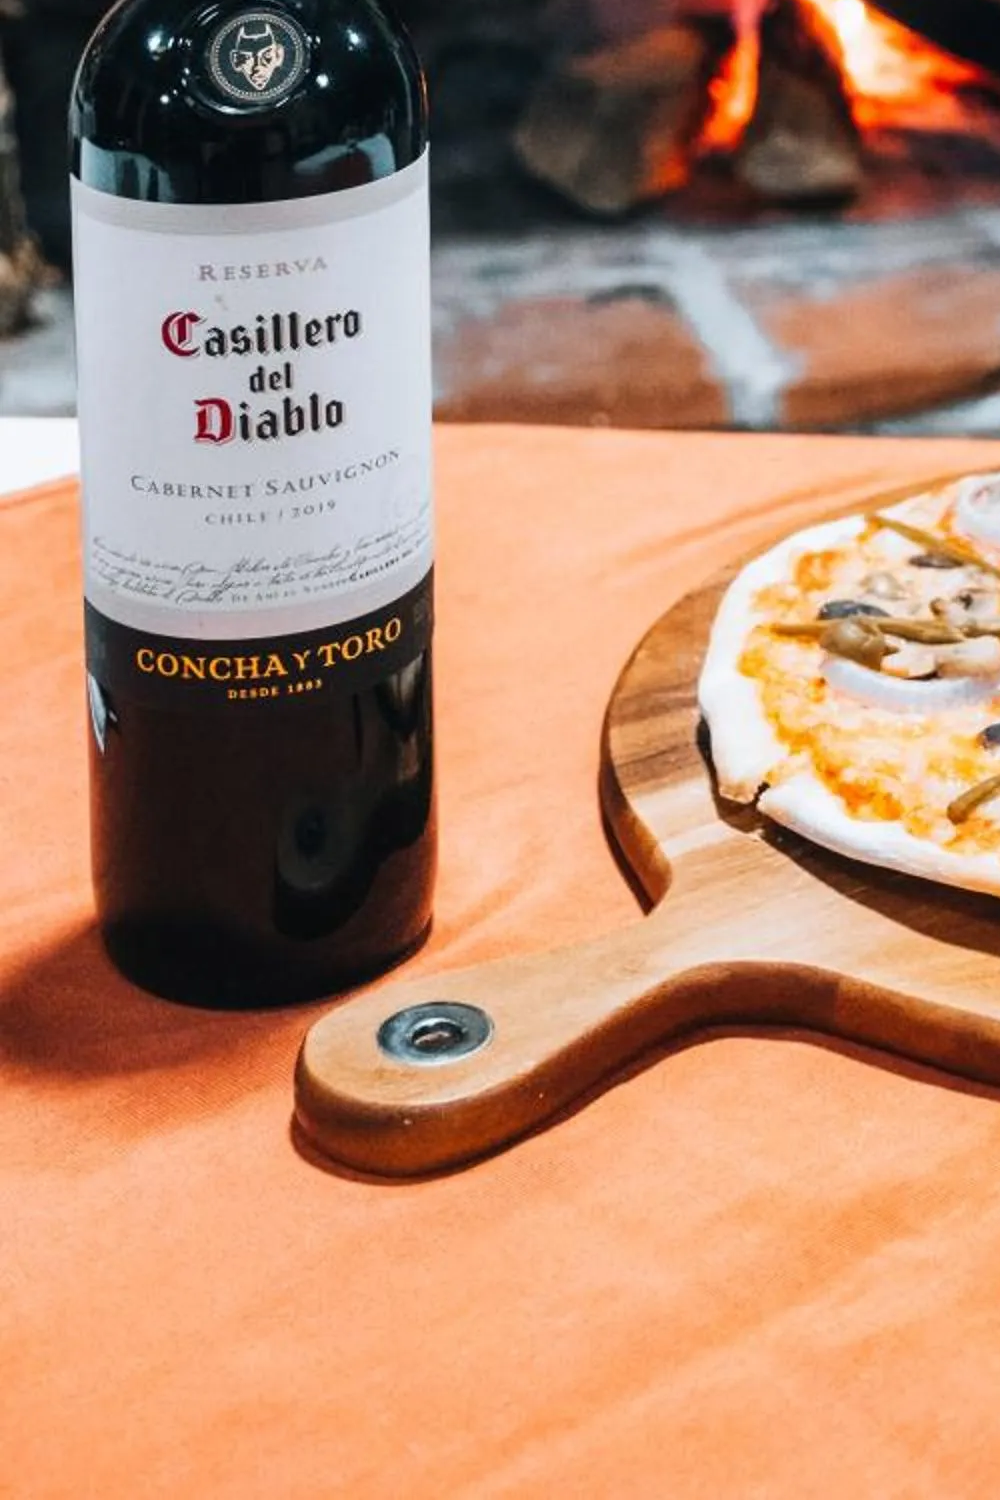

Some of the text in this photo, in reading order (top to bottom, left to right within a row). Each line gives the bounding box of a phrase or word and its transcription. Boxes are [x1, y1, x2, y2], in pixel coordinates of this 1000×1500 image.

[198, 256, 328, 282] RESERVA
[161, 308, 362, 358] Casillero
[249, 362, 293, 394] del
[193, 392, 345, 445] Diablo
[130, 449, 401, 500] CABERNET SAUVIGNON
[204, 511, 267, 526] CHILE
[291, 499, 337, 518] 2019
[136, 616, 402, 681] CONCHA Y TORO
[227, 686, 279, 699] DESDE
